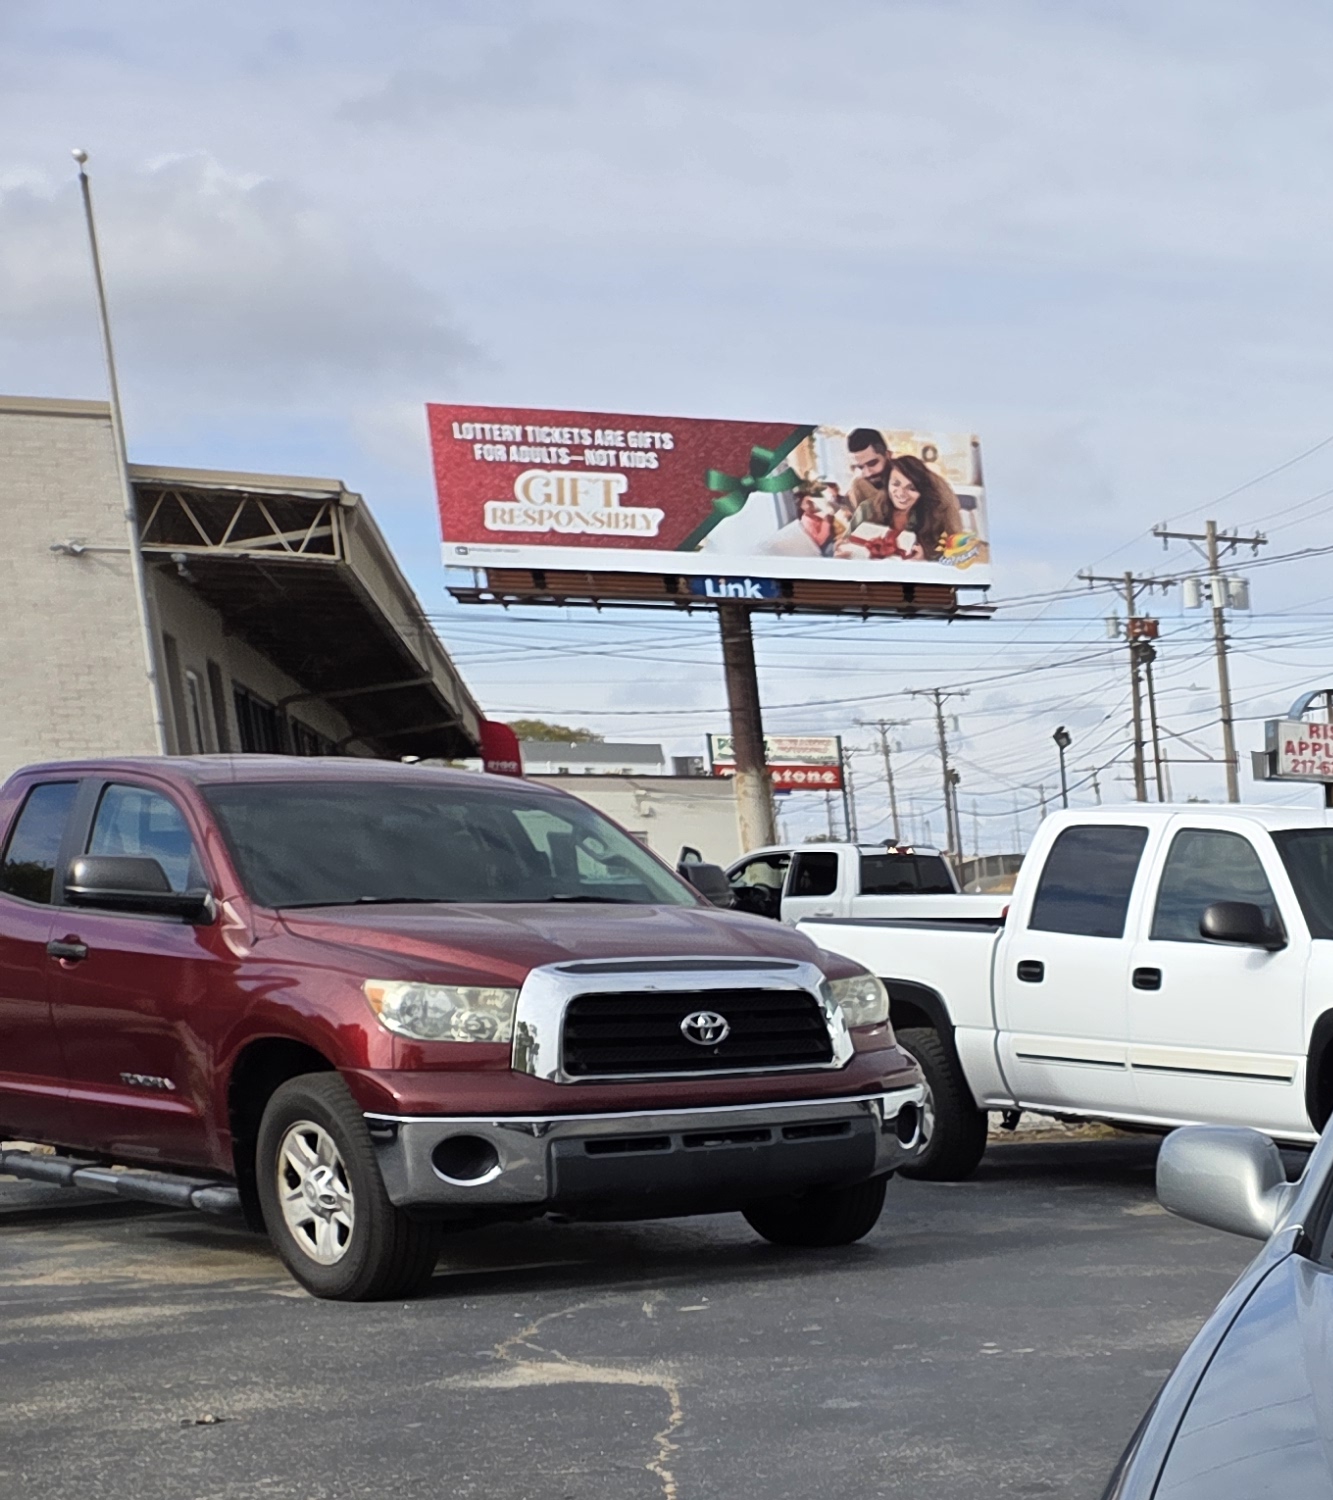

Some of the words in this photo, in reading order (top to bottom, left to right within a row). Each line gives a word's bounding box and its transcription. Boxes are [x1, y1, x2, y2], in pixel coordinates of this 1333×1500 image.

[452, 422, 523, 442] LOTTERY
[524, 425, 593, 446] TICKETS
[594, 428, 626, 447] ARE
[627, 430, 675, 450] GIFTS
[473, 443, 507, 462] FOR
[619, 450, 659, 469] KIDS
[521, 474, 621, 508] GIFT
[490, 506, 657, 531] RESPONSIBLY
[704, 578, 763, 599] Link
